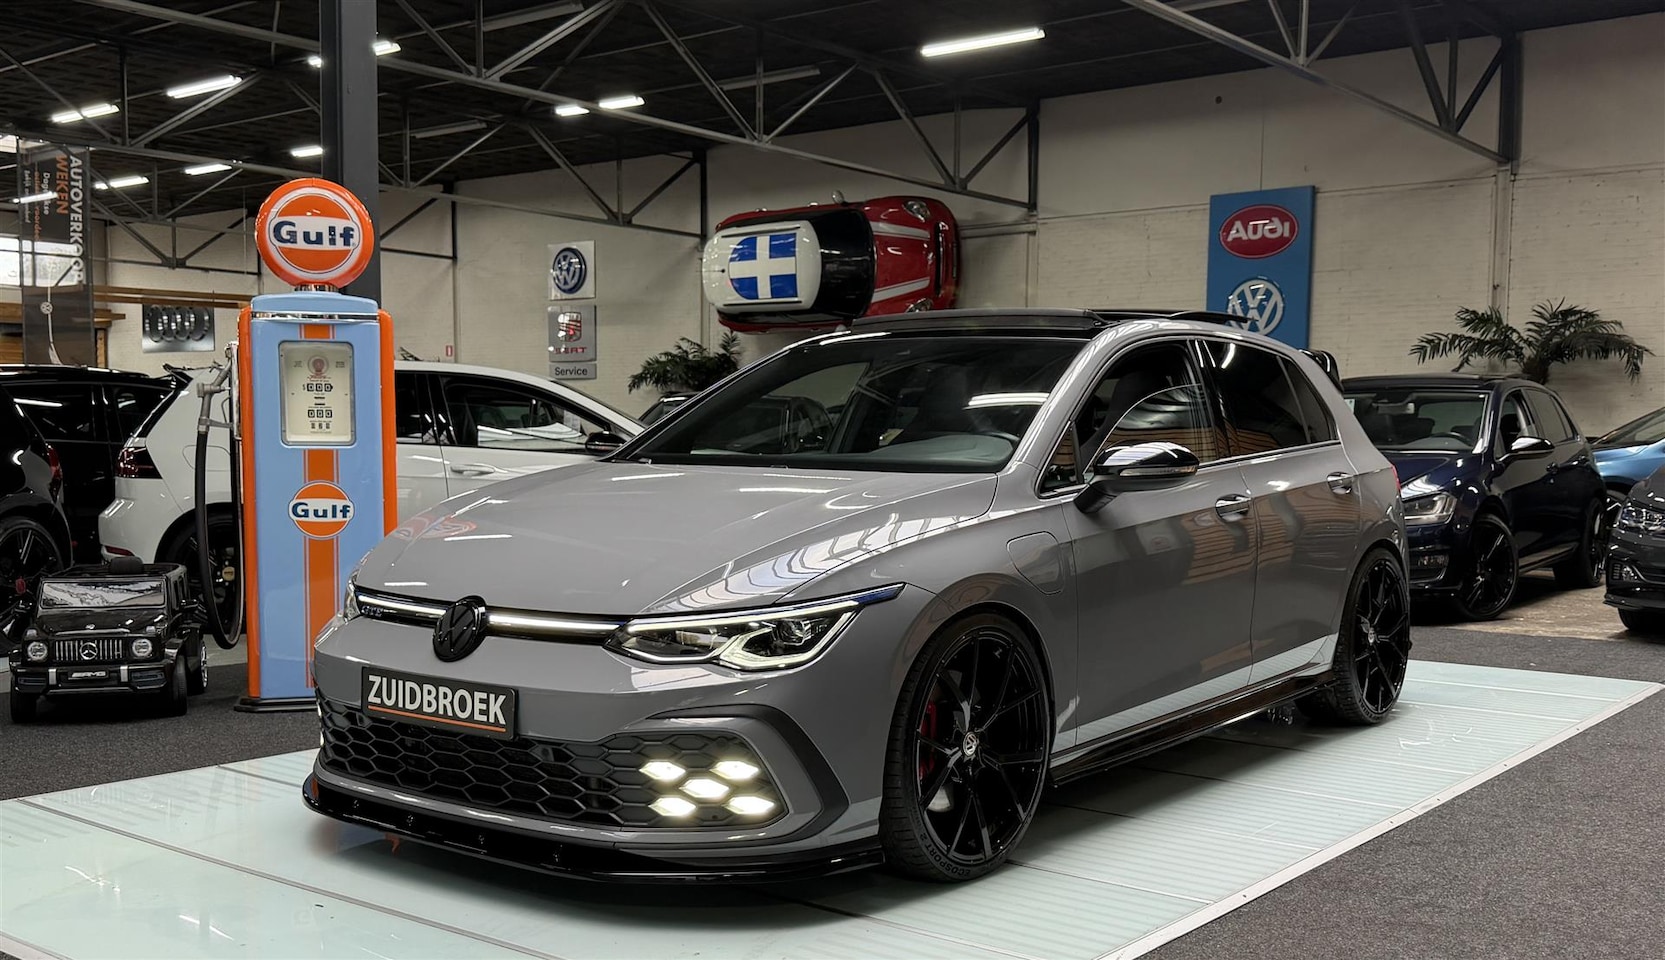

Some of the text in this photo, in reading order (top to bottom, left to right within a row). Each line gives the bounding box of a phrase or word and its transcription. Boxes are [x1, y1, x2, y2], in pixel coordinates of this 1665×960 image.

[56, 154, 68, 215] WEKEN
[273, 221, 354, 246] Gulf
[554, 366, 588, 376] Service
[292, 502, 351, 518] Gulf
[368, 674, 506, 725] ZUIDBROEK
[924, 843, 971, 876] ECOSPORT
